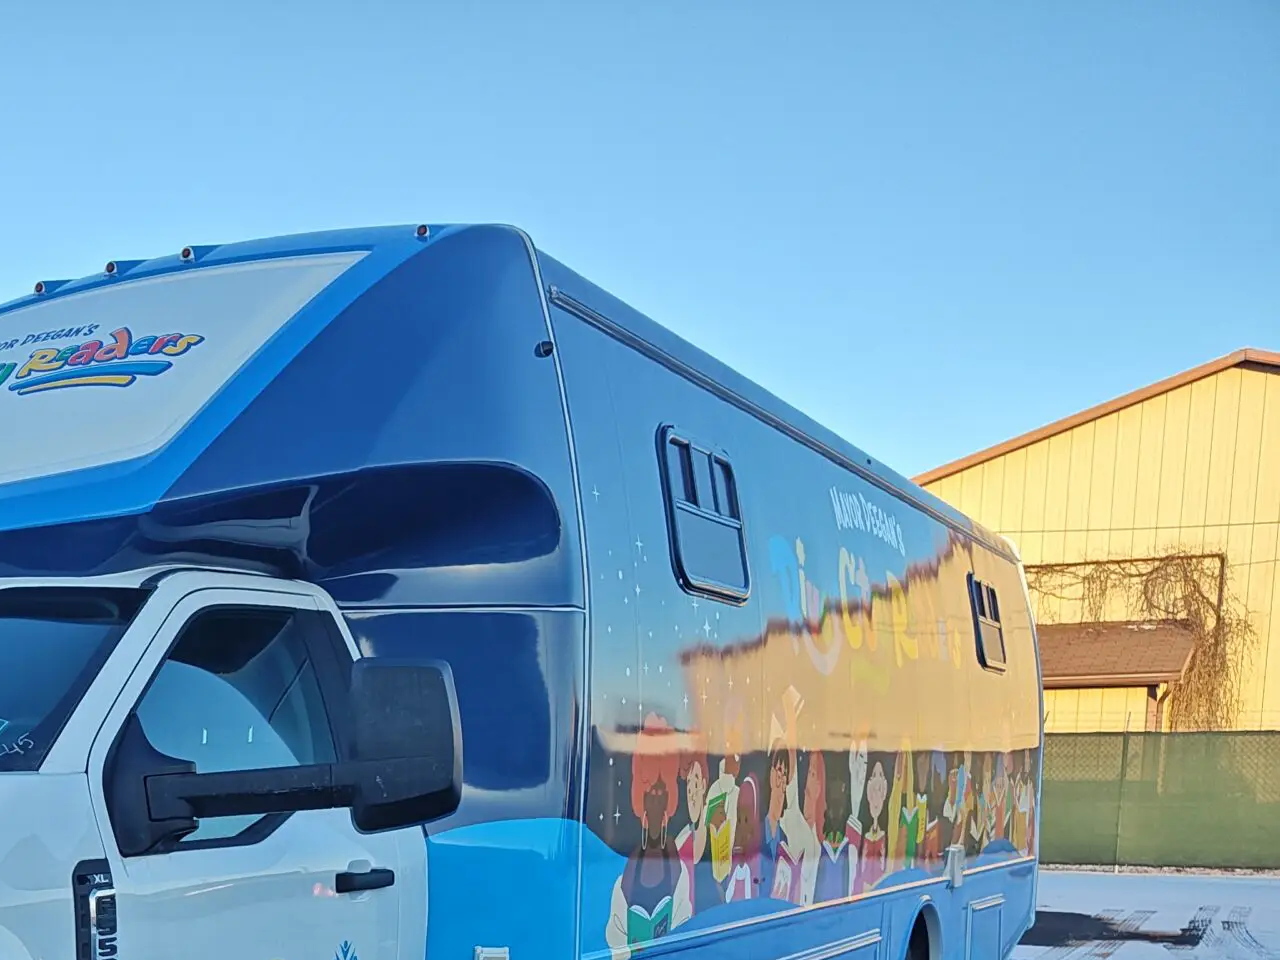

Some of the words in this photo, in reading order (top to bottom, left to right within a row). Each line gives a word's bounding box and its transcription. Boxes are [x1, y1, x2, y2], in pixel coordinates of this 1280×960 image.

[21, 323, 101, 346] DEEGAN'S
[16, 326, 205, 379] Readers
[829, 485, 865, 533] MAYOR
[93, 873, 109, 884] XL
